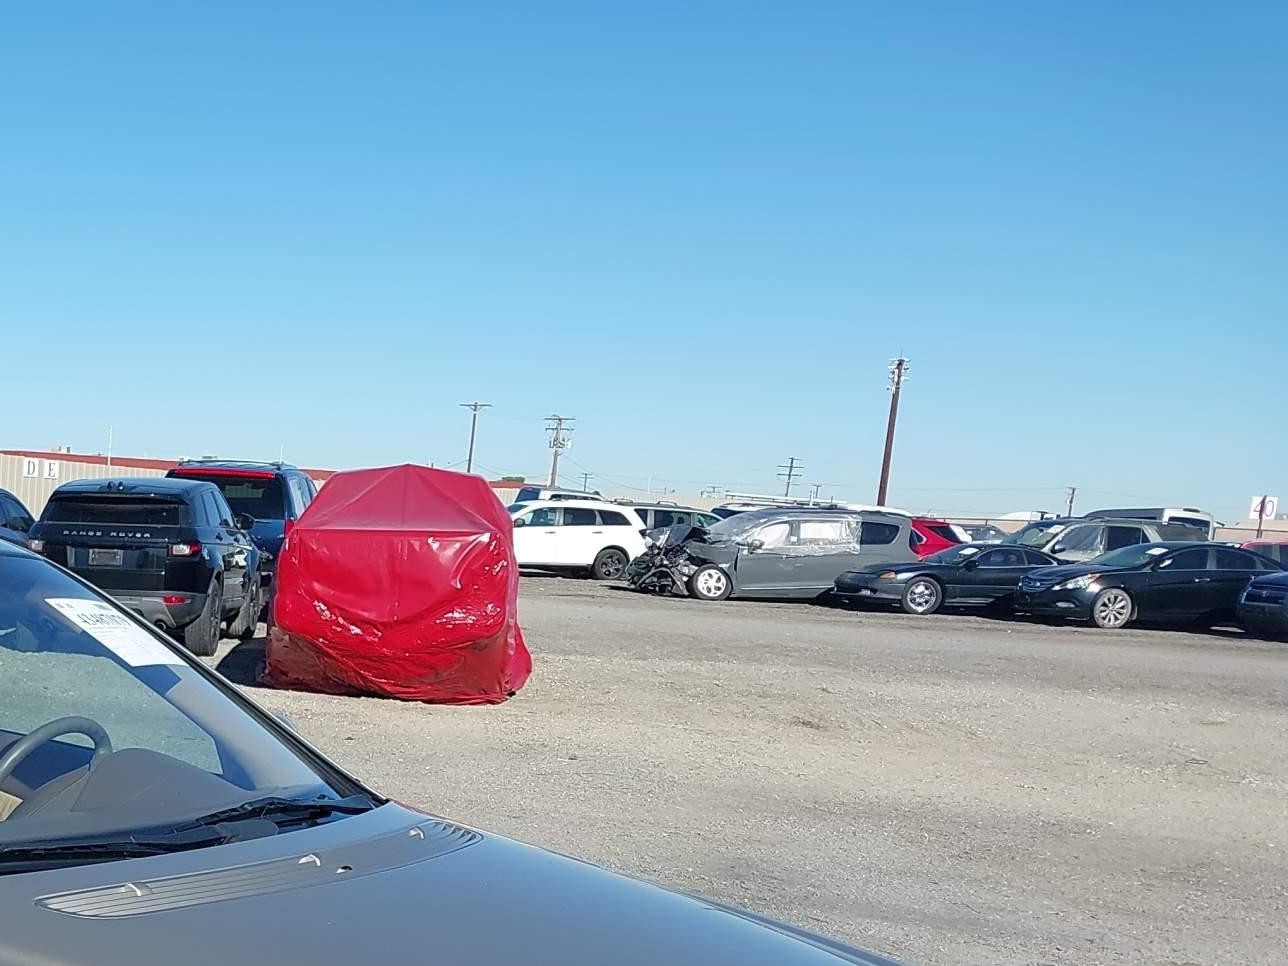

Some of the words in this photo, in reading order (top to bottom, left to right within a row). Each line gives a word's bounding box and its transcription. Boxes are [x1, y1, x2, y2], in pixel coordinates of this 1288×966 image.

[26, 460, 36, 476] D
[48, 462, 57, 477] E
[1253, 499, 1275, 518] 40
